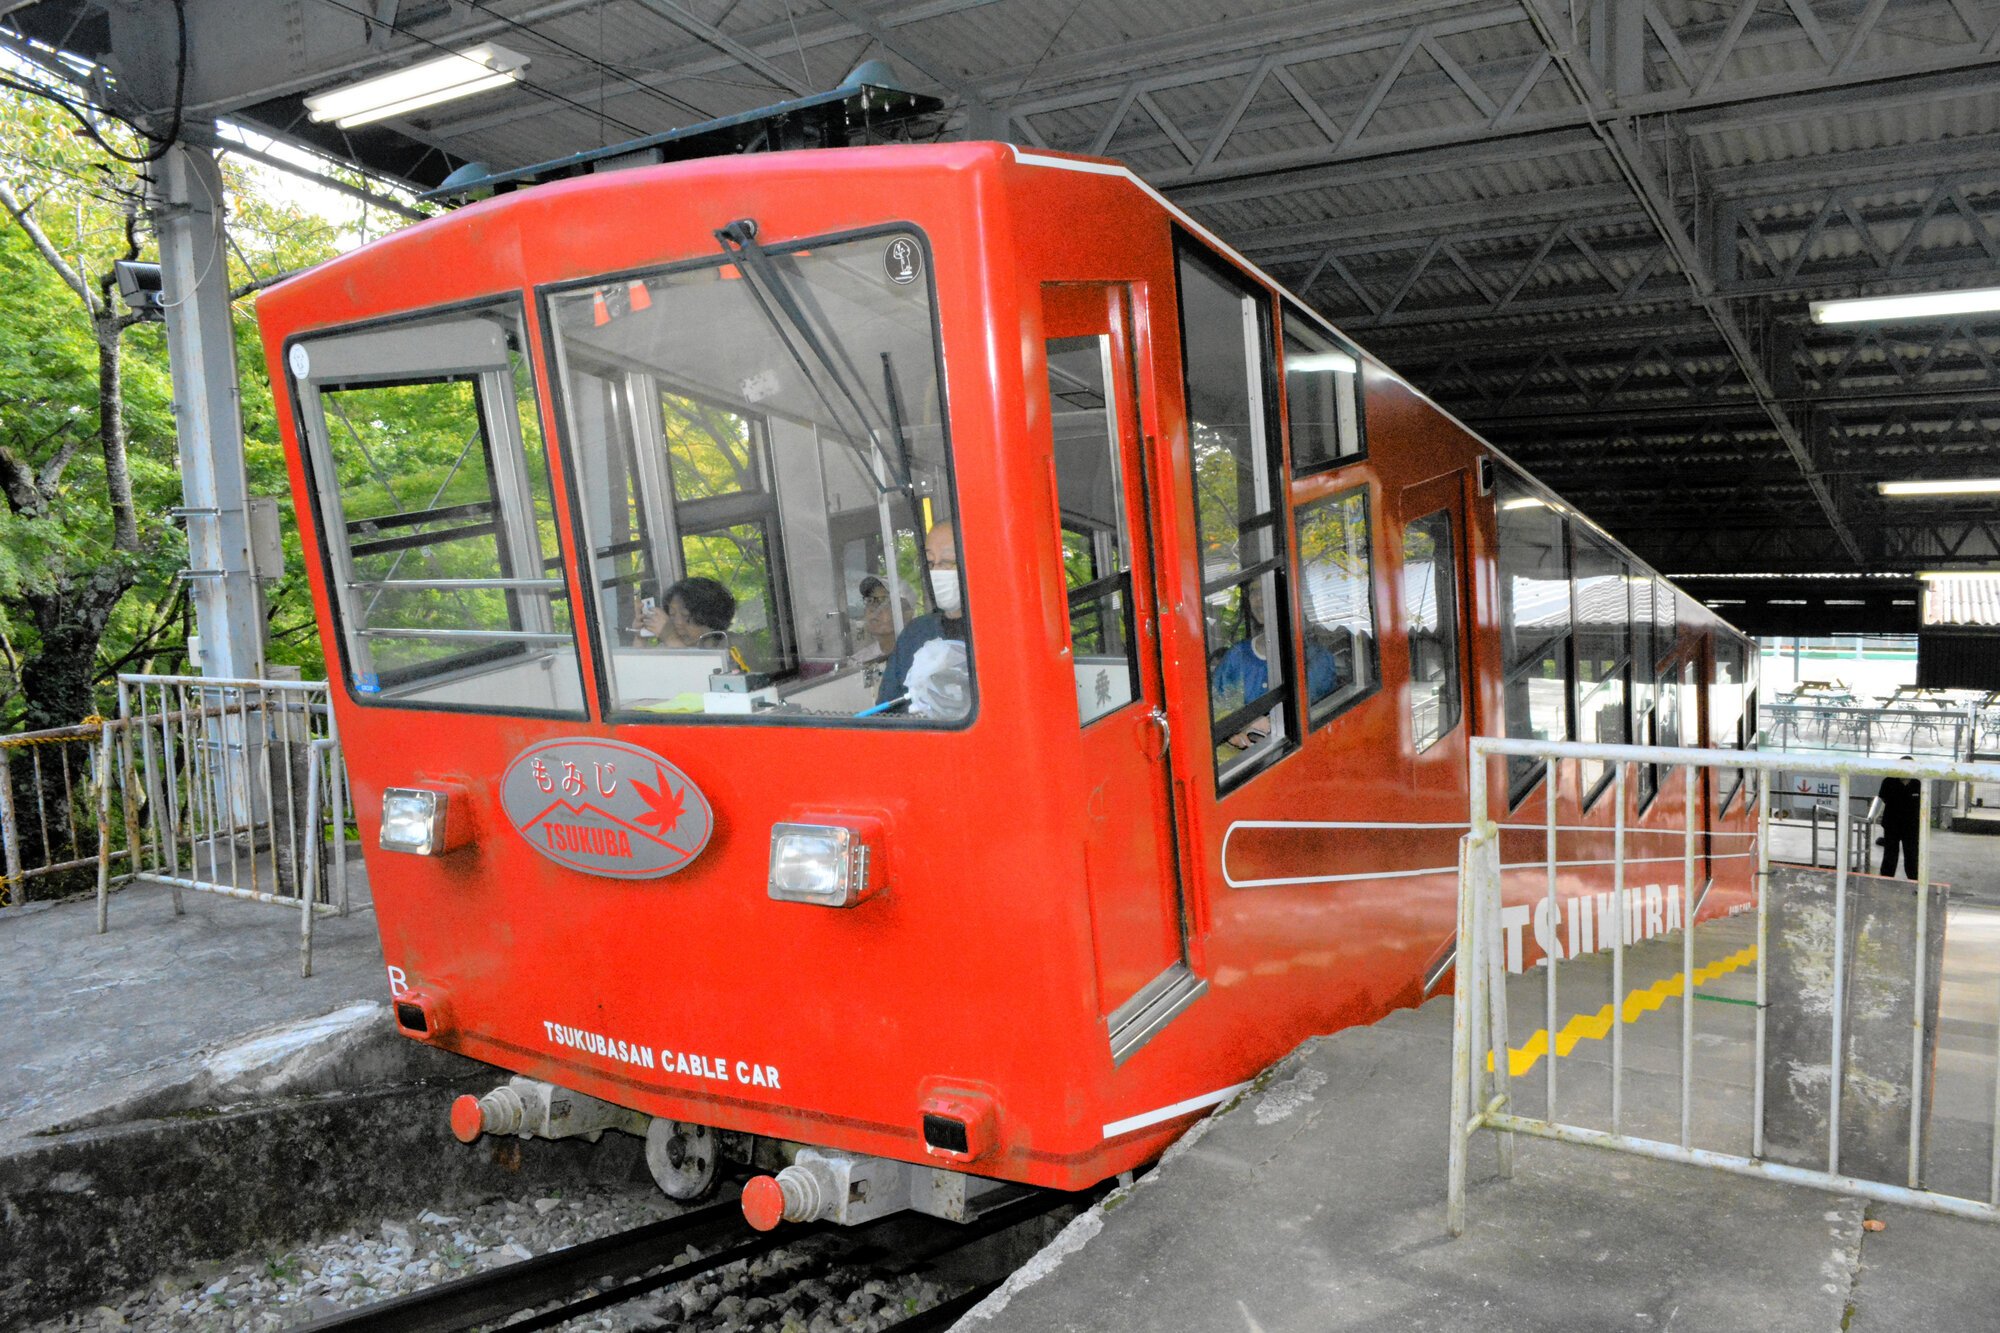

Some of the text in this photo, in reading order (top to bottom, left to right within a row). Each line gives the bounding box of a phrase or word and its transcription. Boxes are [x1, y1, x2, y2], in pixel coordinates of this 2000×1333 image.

[531, 758, 617, 798] もみじ
[1817, 783, 1840, 795] 出口
[543, 822, 633, 858] TSUKUBA
[543, 1020, 781, 1090] TSUKUBASAN CABLE CAR
